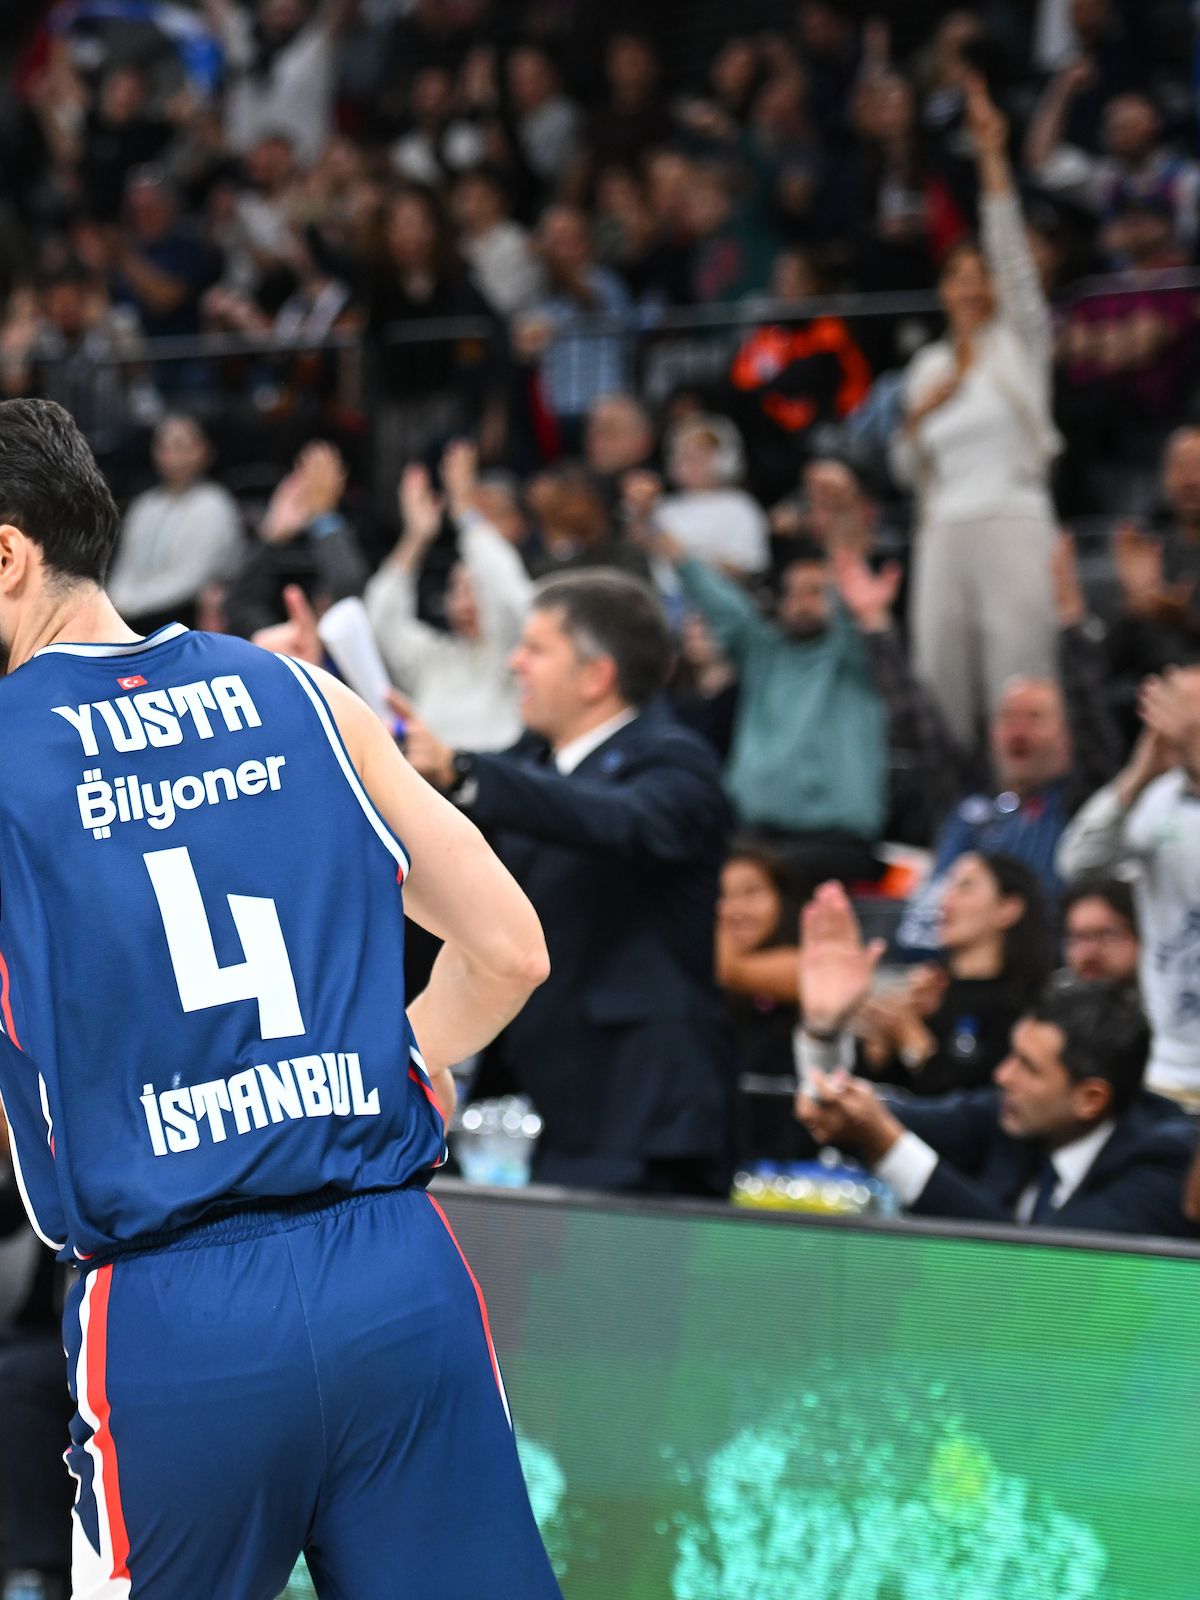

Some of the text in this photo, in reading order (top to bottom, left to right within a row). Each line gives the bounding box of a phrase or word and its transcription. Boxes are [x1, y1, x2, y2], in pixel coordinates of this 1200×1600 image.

[50, 674, 263, 757] YUSTA
[76, 755, 287, 840] Bilyoner
[142, 846, 306, 1040] 4
[139, 1052, 381, 1156] İSTANBUL
